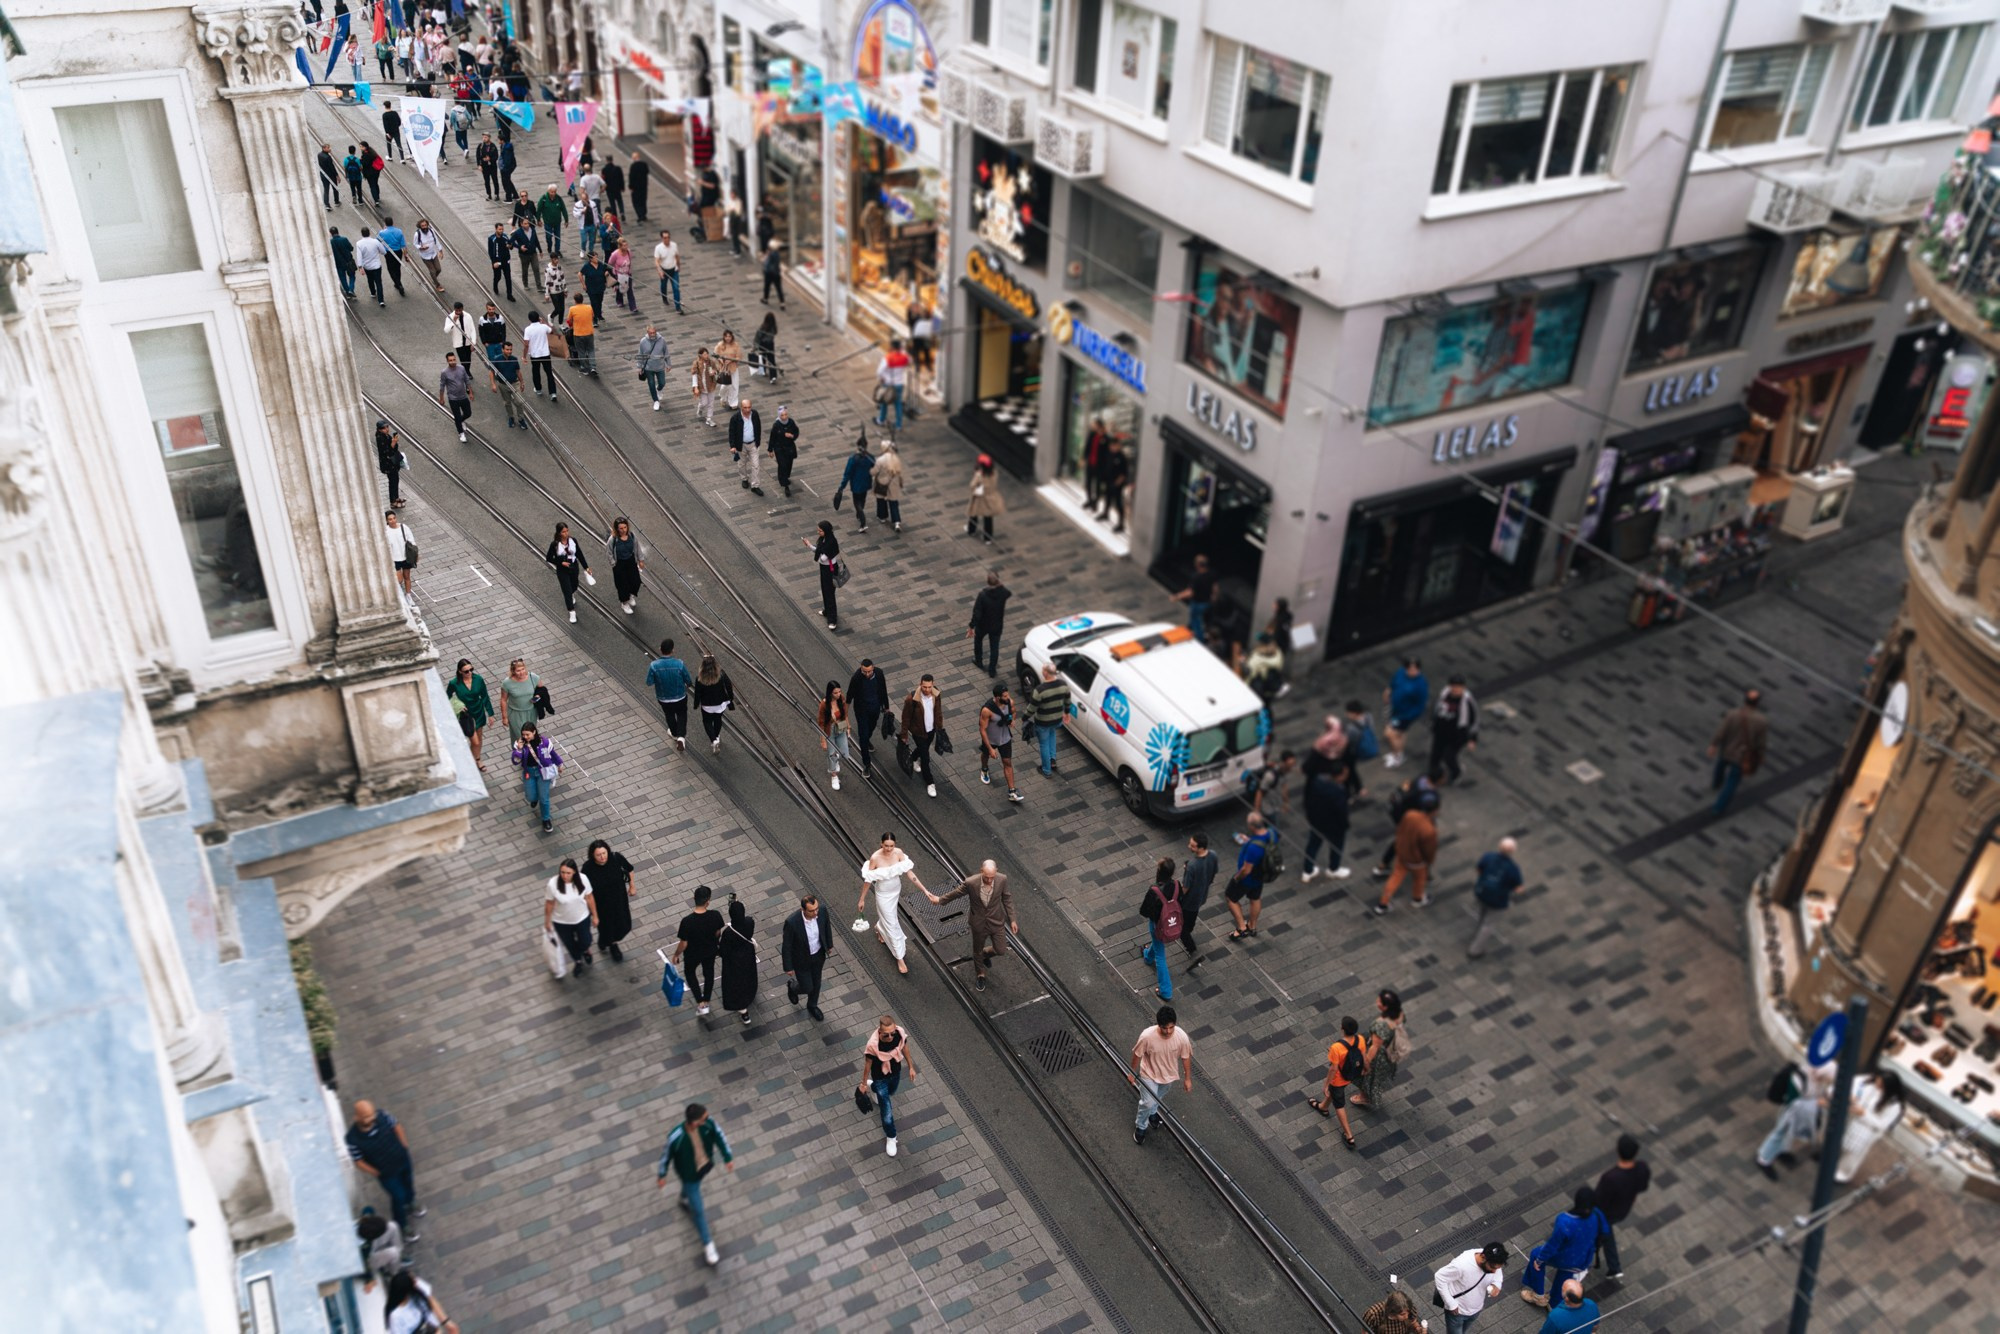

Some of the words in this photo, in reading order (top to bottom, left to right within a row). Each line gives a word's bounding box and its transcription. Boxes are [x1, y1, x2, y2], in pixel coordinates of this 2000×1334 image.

[1072, 319, 1146, 392] TURKCELL
[1646, 366, 1721, 411] LELAS
[1187, 382, 1256, 451] LELAS
[1433, 415, 1518, 462] LELAS
[1110, 696, 1127, 718] 187
